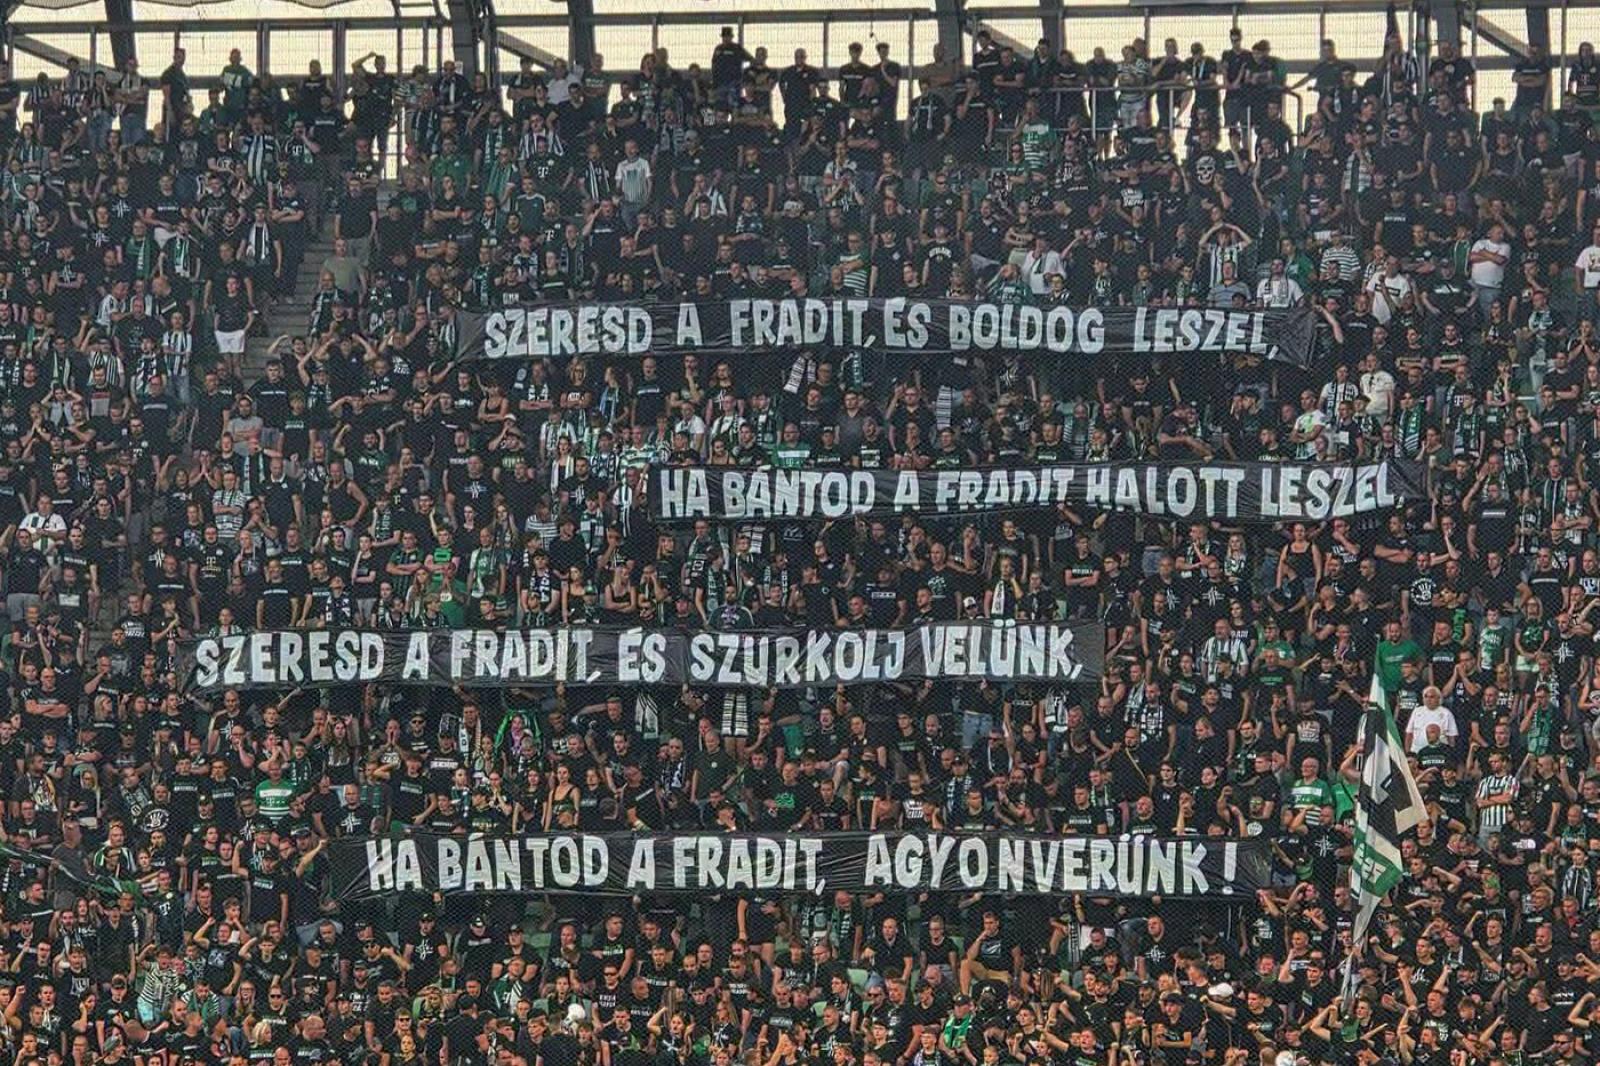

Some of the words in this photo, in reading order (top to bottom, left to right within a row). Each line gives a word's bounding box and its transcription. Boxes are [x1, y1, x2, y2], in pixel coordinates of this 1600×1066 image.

[484, 306, 653, 358] SZERESD
[677, 302, 702, 346] A
[730, 297, 877, 349] FRADIT,
[948, 303, 1106, 354] BOLDOG
[1133, 305, 1281, 360] LESZEL,
[660, 469, 711, 519] HA
[721, 463, 878, 518] BÁNTOD
[894, 470, 921, 511] A
[1086, 467, 1246, 519] HALOTT
[196, 629, 386, 688] SZERESD
[402, 631, 430, 681] A
[450, 628, 601, 684] FRADIT,
[617, 626, 667, 683] ÉS
[690, 629, 906, 686] SZURKOLJ
[919, 619, 1084, 680] VELÜNK,
[366, 839, 424, 892] HA
[438, 831, 610, 892] BÁNTOD
[626, 838, 656, 891] A
[673, 835, 827, 896] FRADIT,
